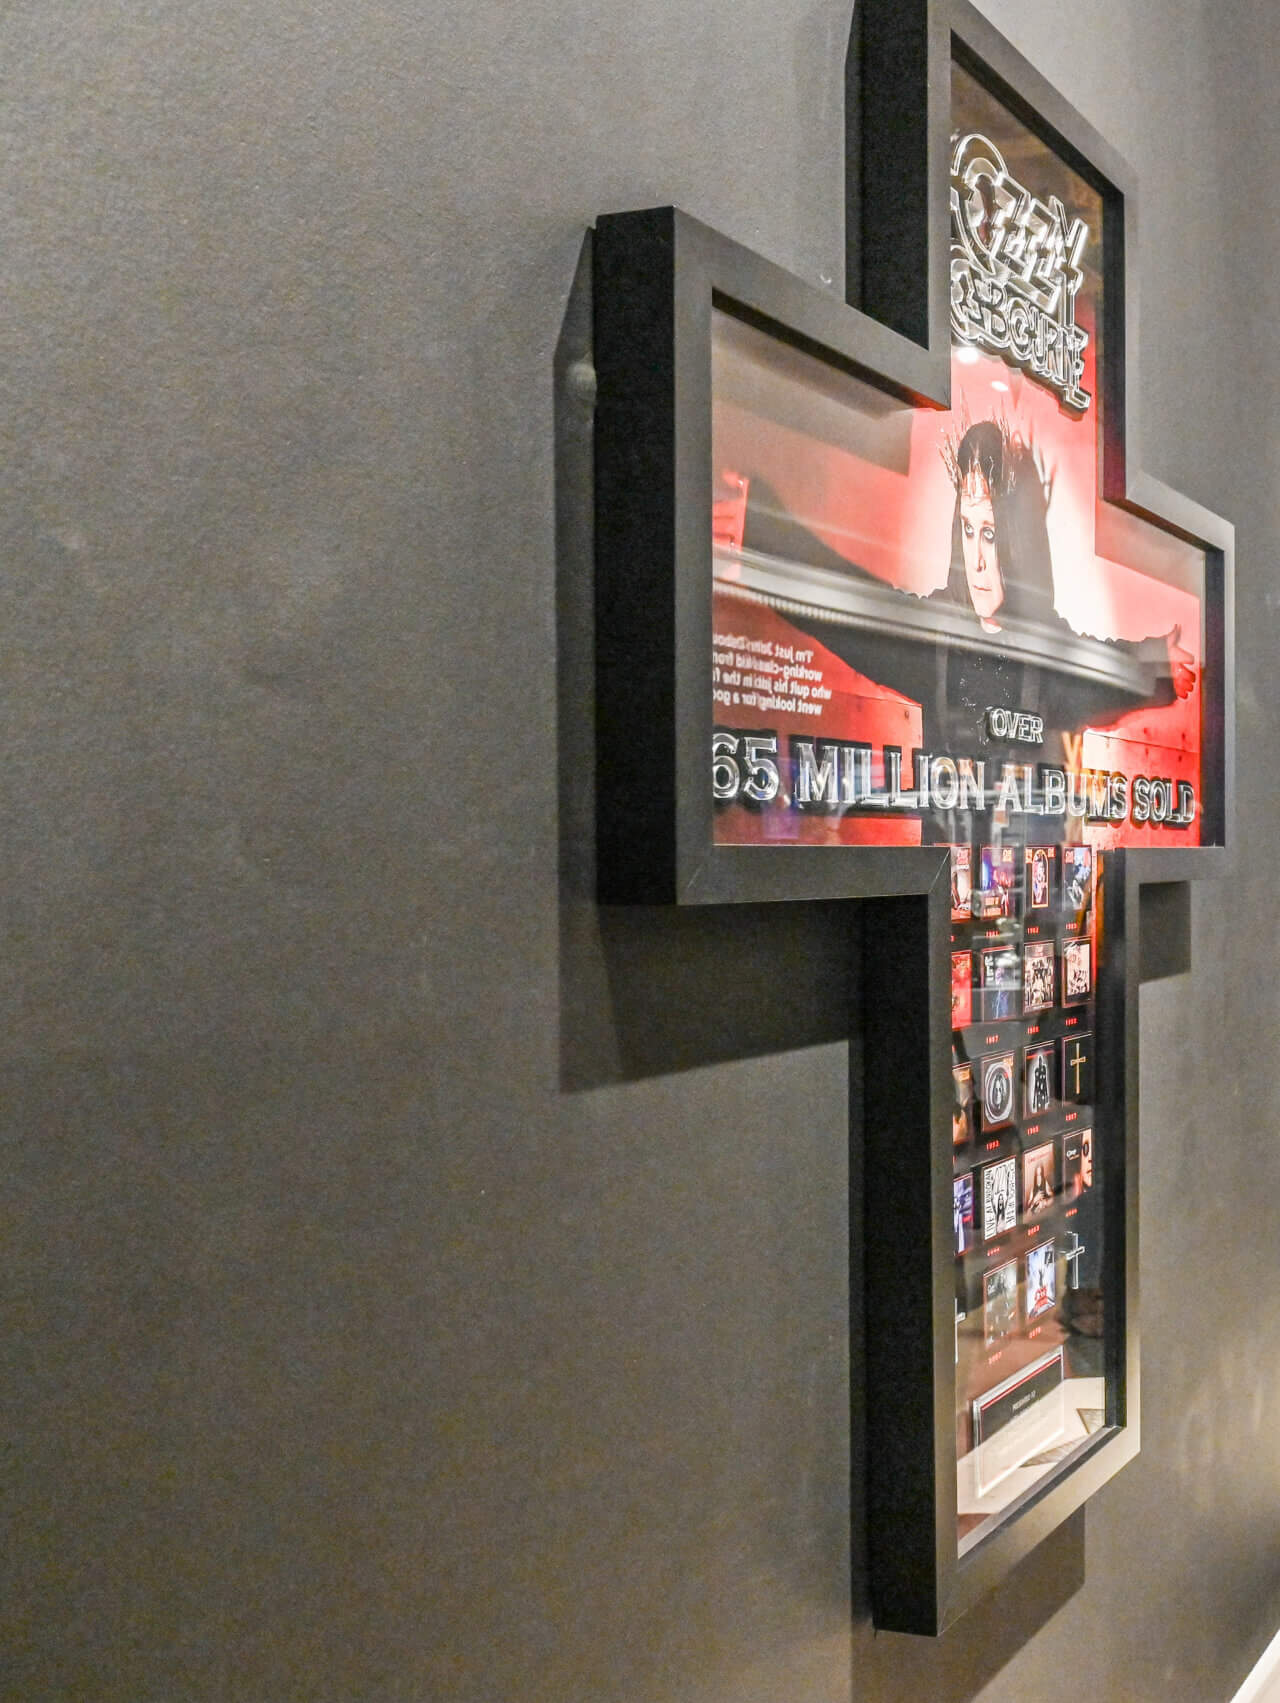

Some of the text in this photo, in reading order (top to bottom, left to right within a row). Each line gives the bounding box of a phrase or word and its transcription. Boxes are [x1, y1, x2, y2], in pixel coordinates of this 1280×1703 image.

[987, 707, 1044, 744] OVER
[713, 730, 1195, 824] 65 MILLION ALBUMS SOLD
